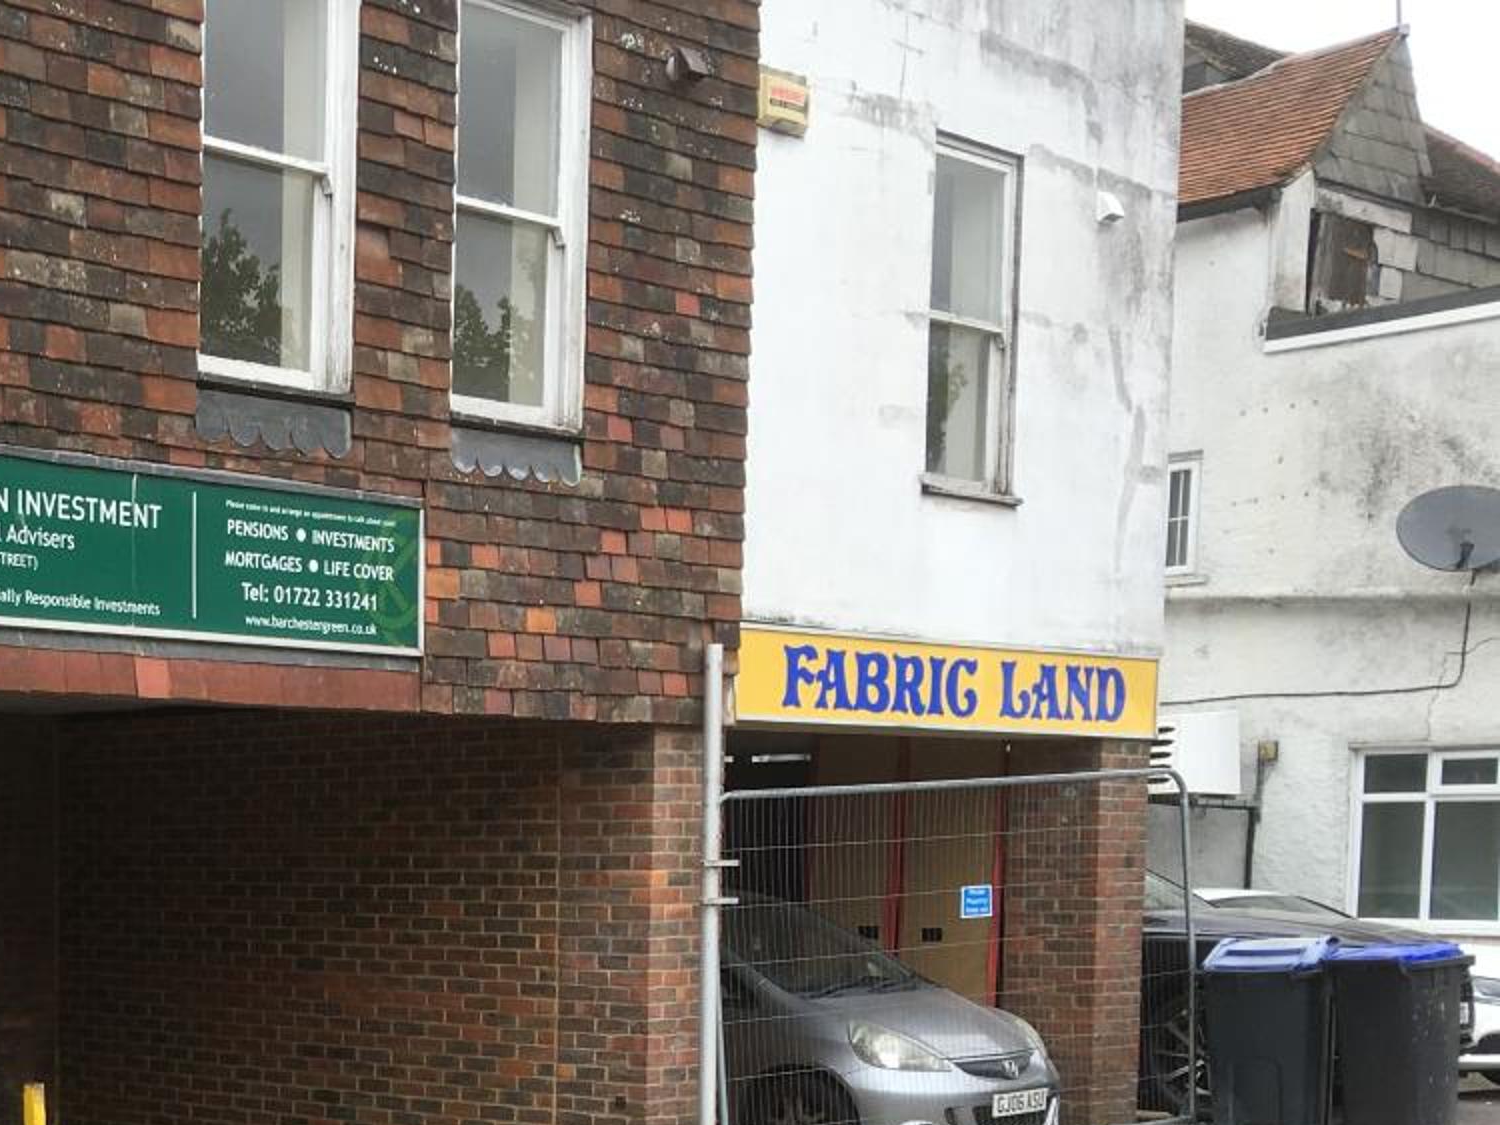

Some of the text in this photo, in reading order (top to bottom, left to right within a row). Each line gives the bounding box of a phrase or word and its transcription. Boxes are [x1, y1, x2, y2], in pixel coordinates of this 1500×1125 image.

[17, 489, 162, 529] INVESTMENT
[6, 524, 75, 550] Advisers
[227, 519, 395, 552] PENSIONS INVESTMENTS
[225, 550, 394, 581] MORTGAGES LIFE COVER
[24, 589, 91, 609] Responsible
[93, 596, 161, 615] Investments
[241, 581, 377, 611] Tel: 01722 331241
[245, 614, 377, 635] www.barchestergreen.co.uk
[999, 660, 1126, 722] LAND
